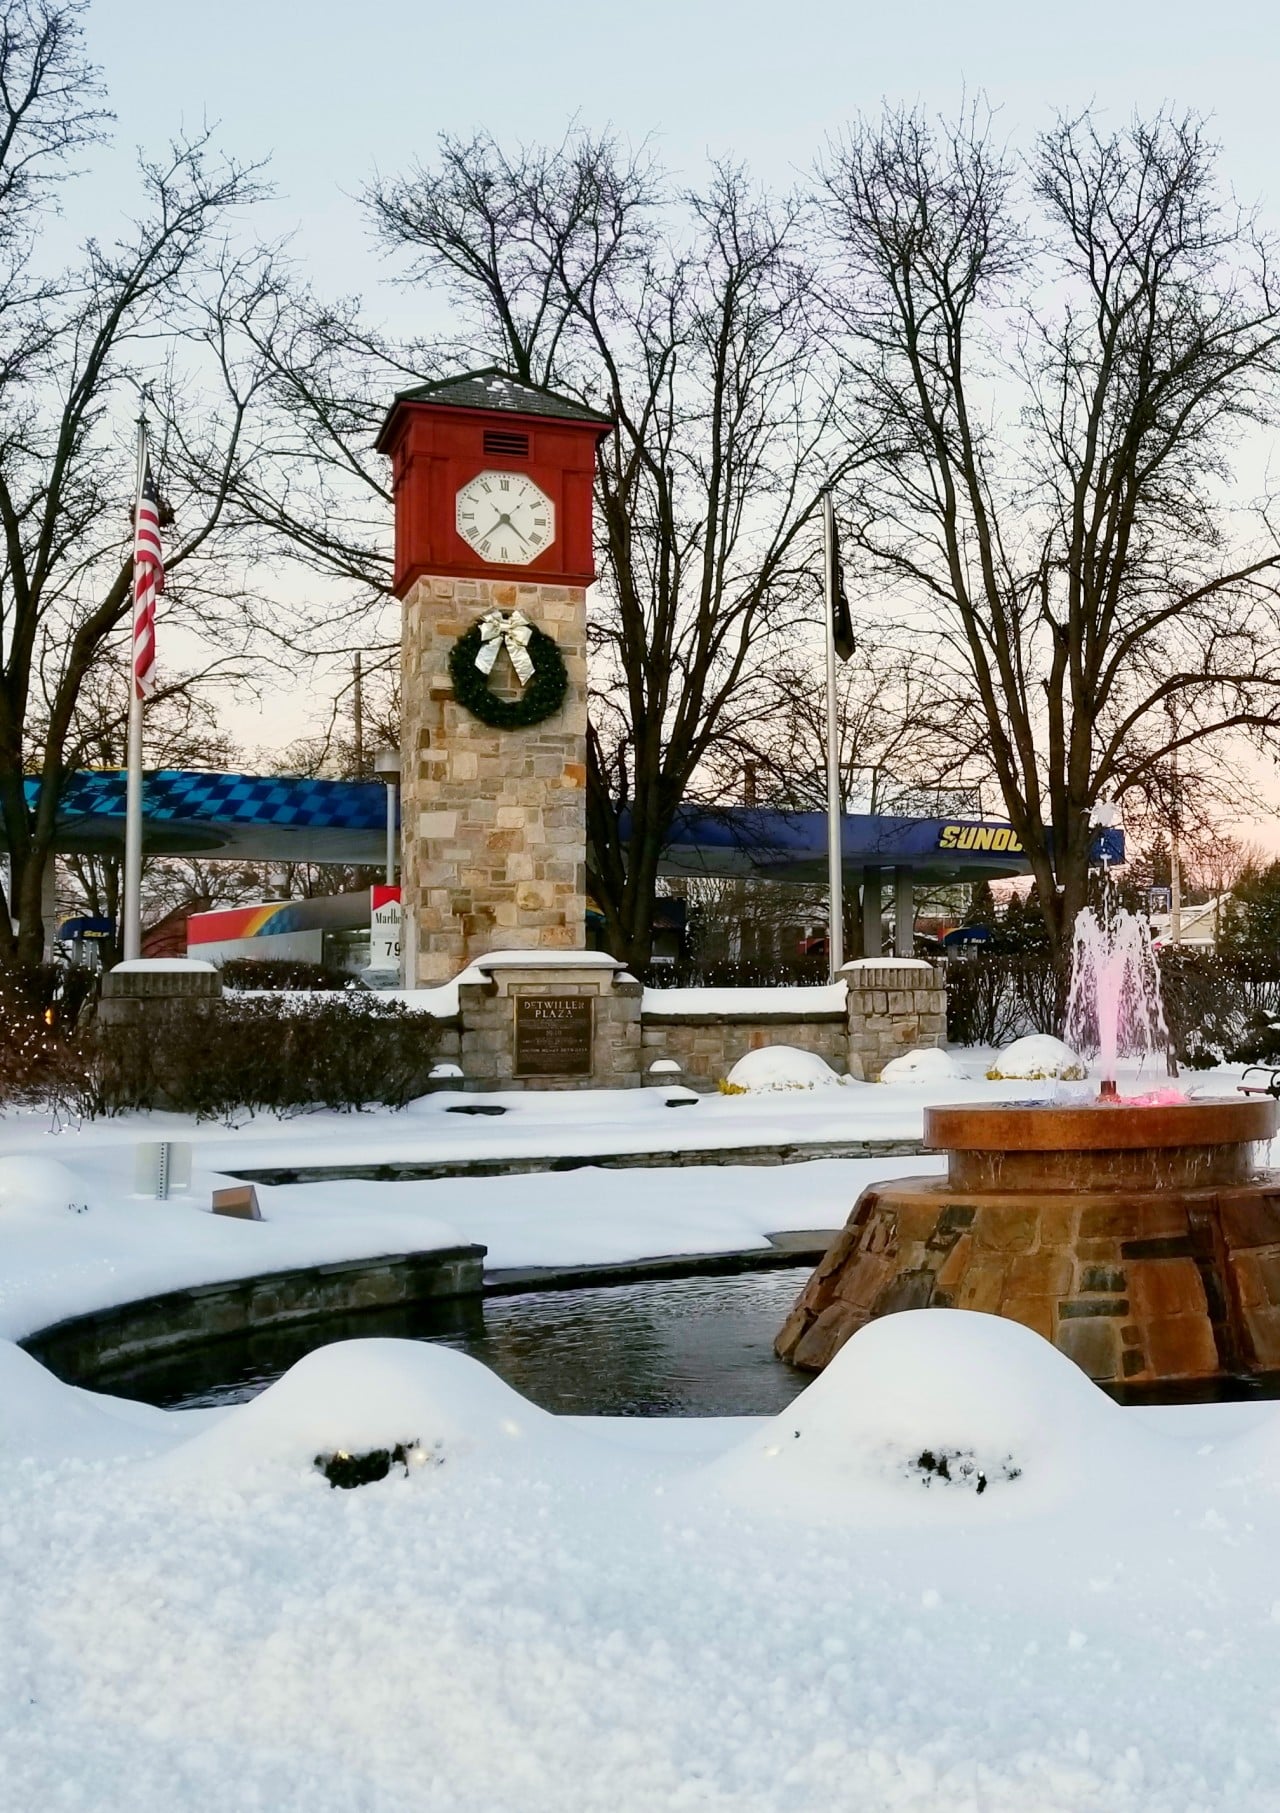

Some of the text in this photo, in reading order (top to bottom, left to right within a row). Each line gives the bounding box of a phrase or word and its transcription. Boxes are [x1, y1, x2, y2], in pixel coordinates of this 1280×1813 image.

[939, 825, 1023, 852] SUNOC
[375, 908, 401, 924] Marlbo
[524, 1001, 585, 1010] DETWILLER
[535, 1009, 573, 1018] PLAZA
